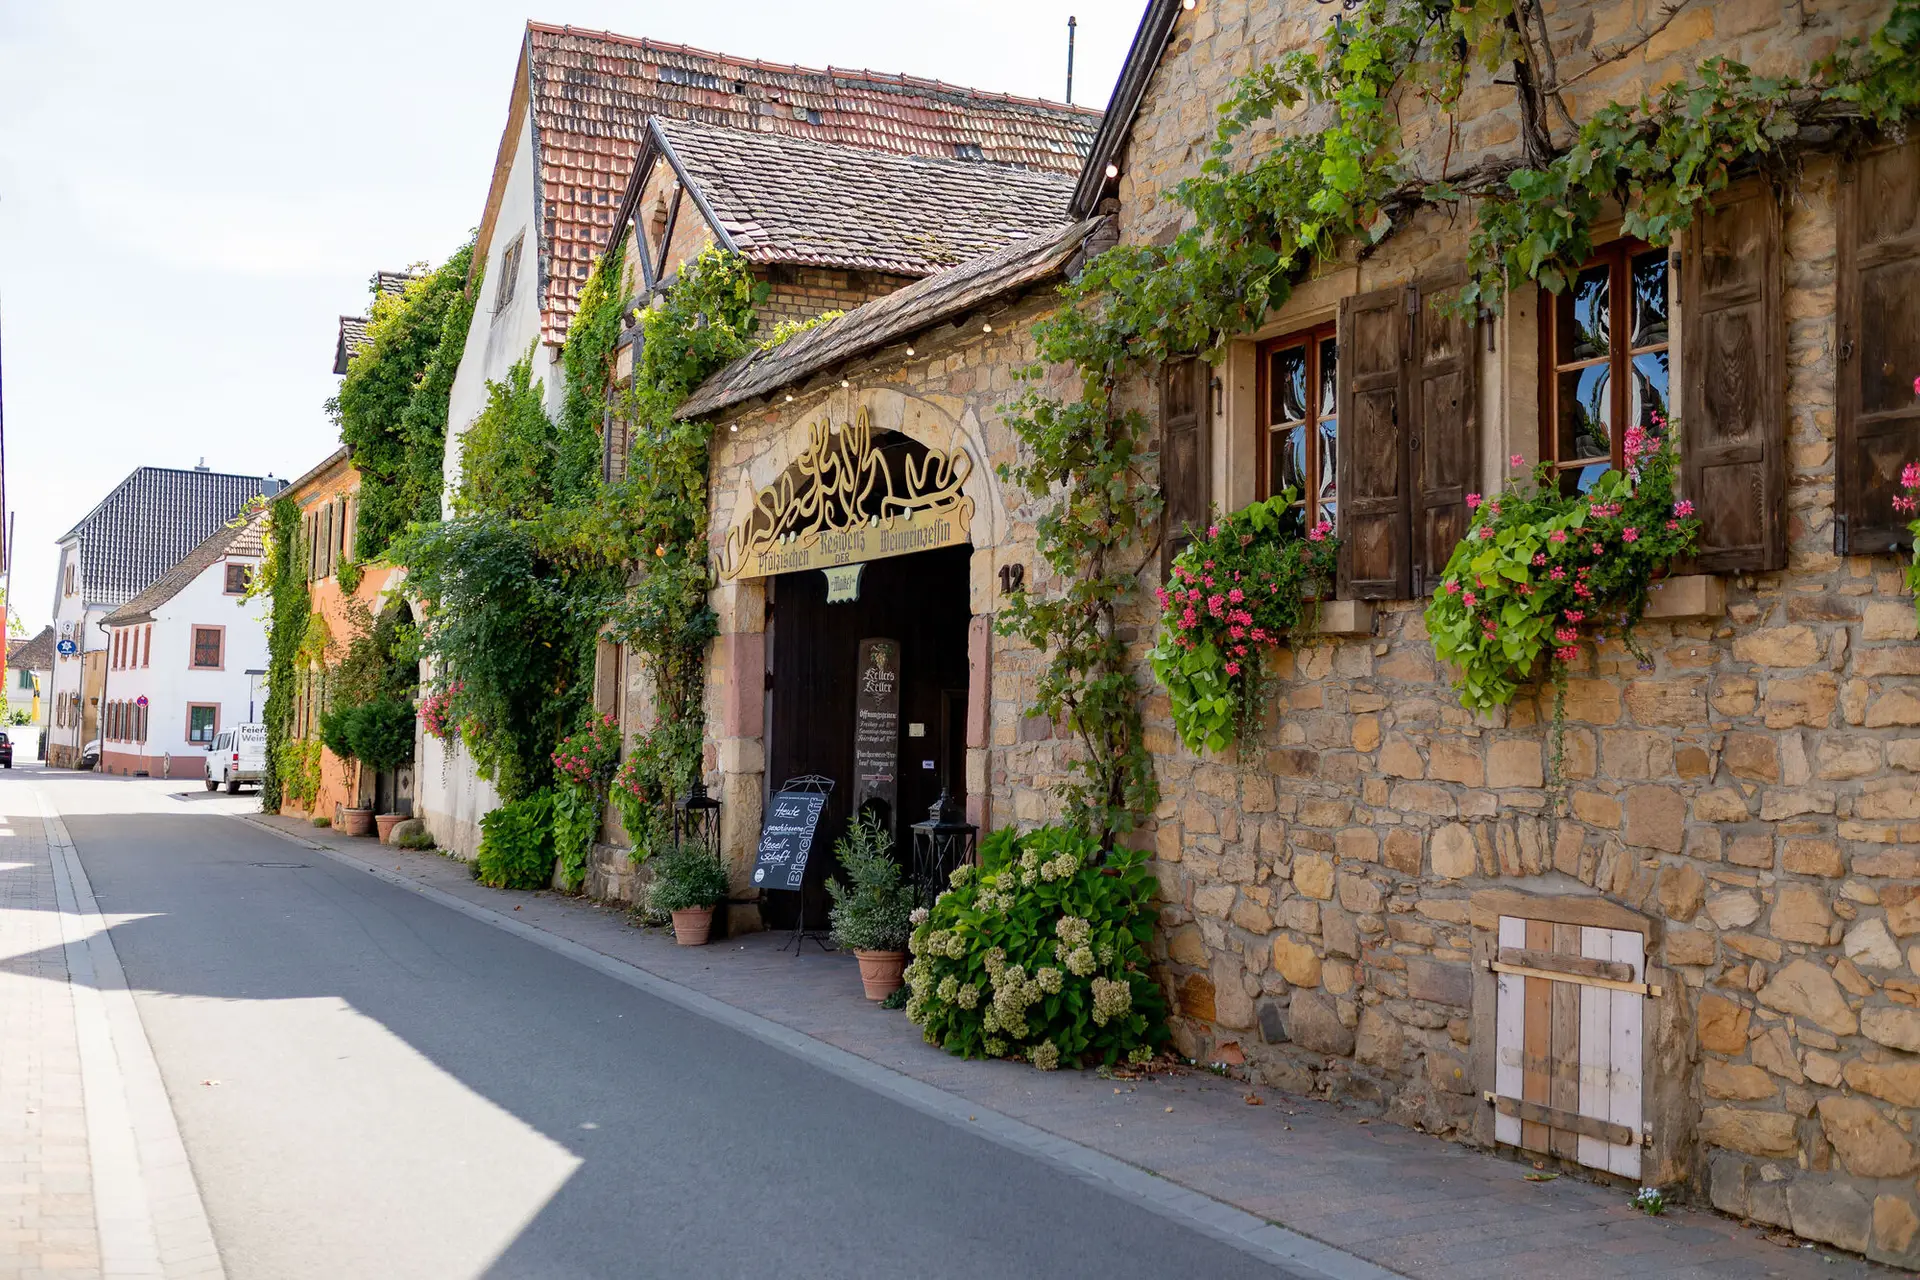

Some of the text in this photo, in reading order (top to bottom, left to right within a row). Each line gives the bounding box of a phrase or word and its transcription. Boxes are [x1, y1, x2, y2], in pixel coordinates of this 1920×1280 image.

[820, 530, 865, 555] Residenz
[834, 552, 850, 564] DER
[998, 563, 1025, 593] 12
[241, 734, 267, 742] Wein
[774, 802, 800, 817] Heute
[787, 797, 824, 886] Bischoff
